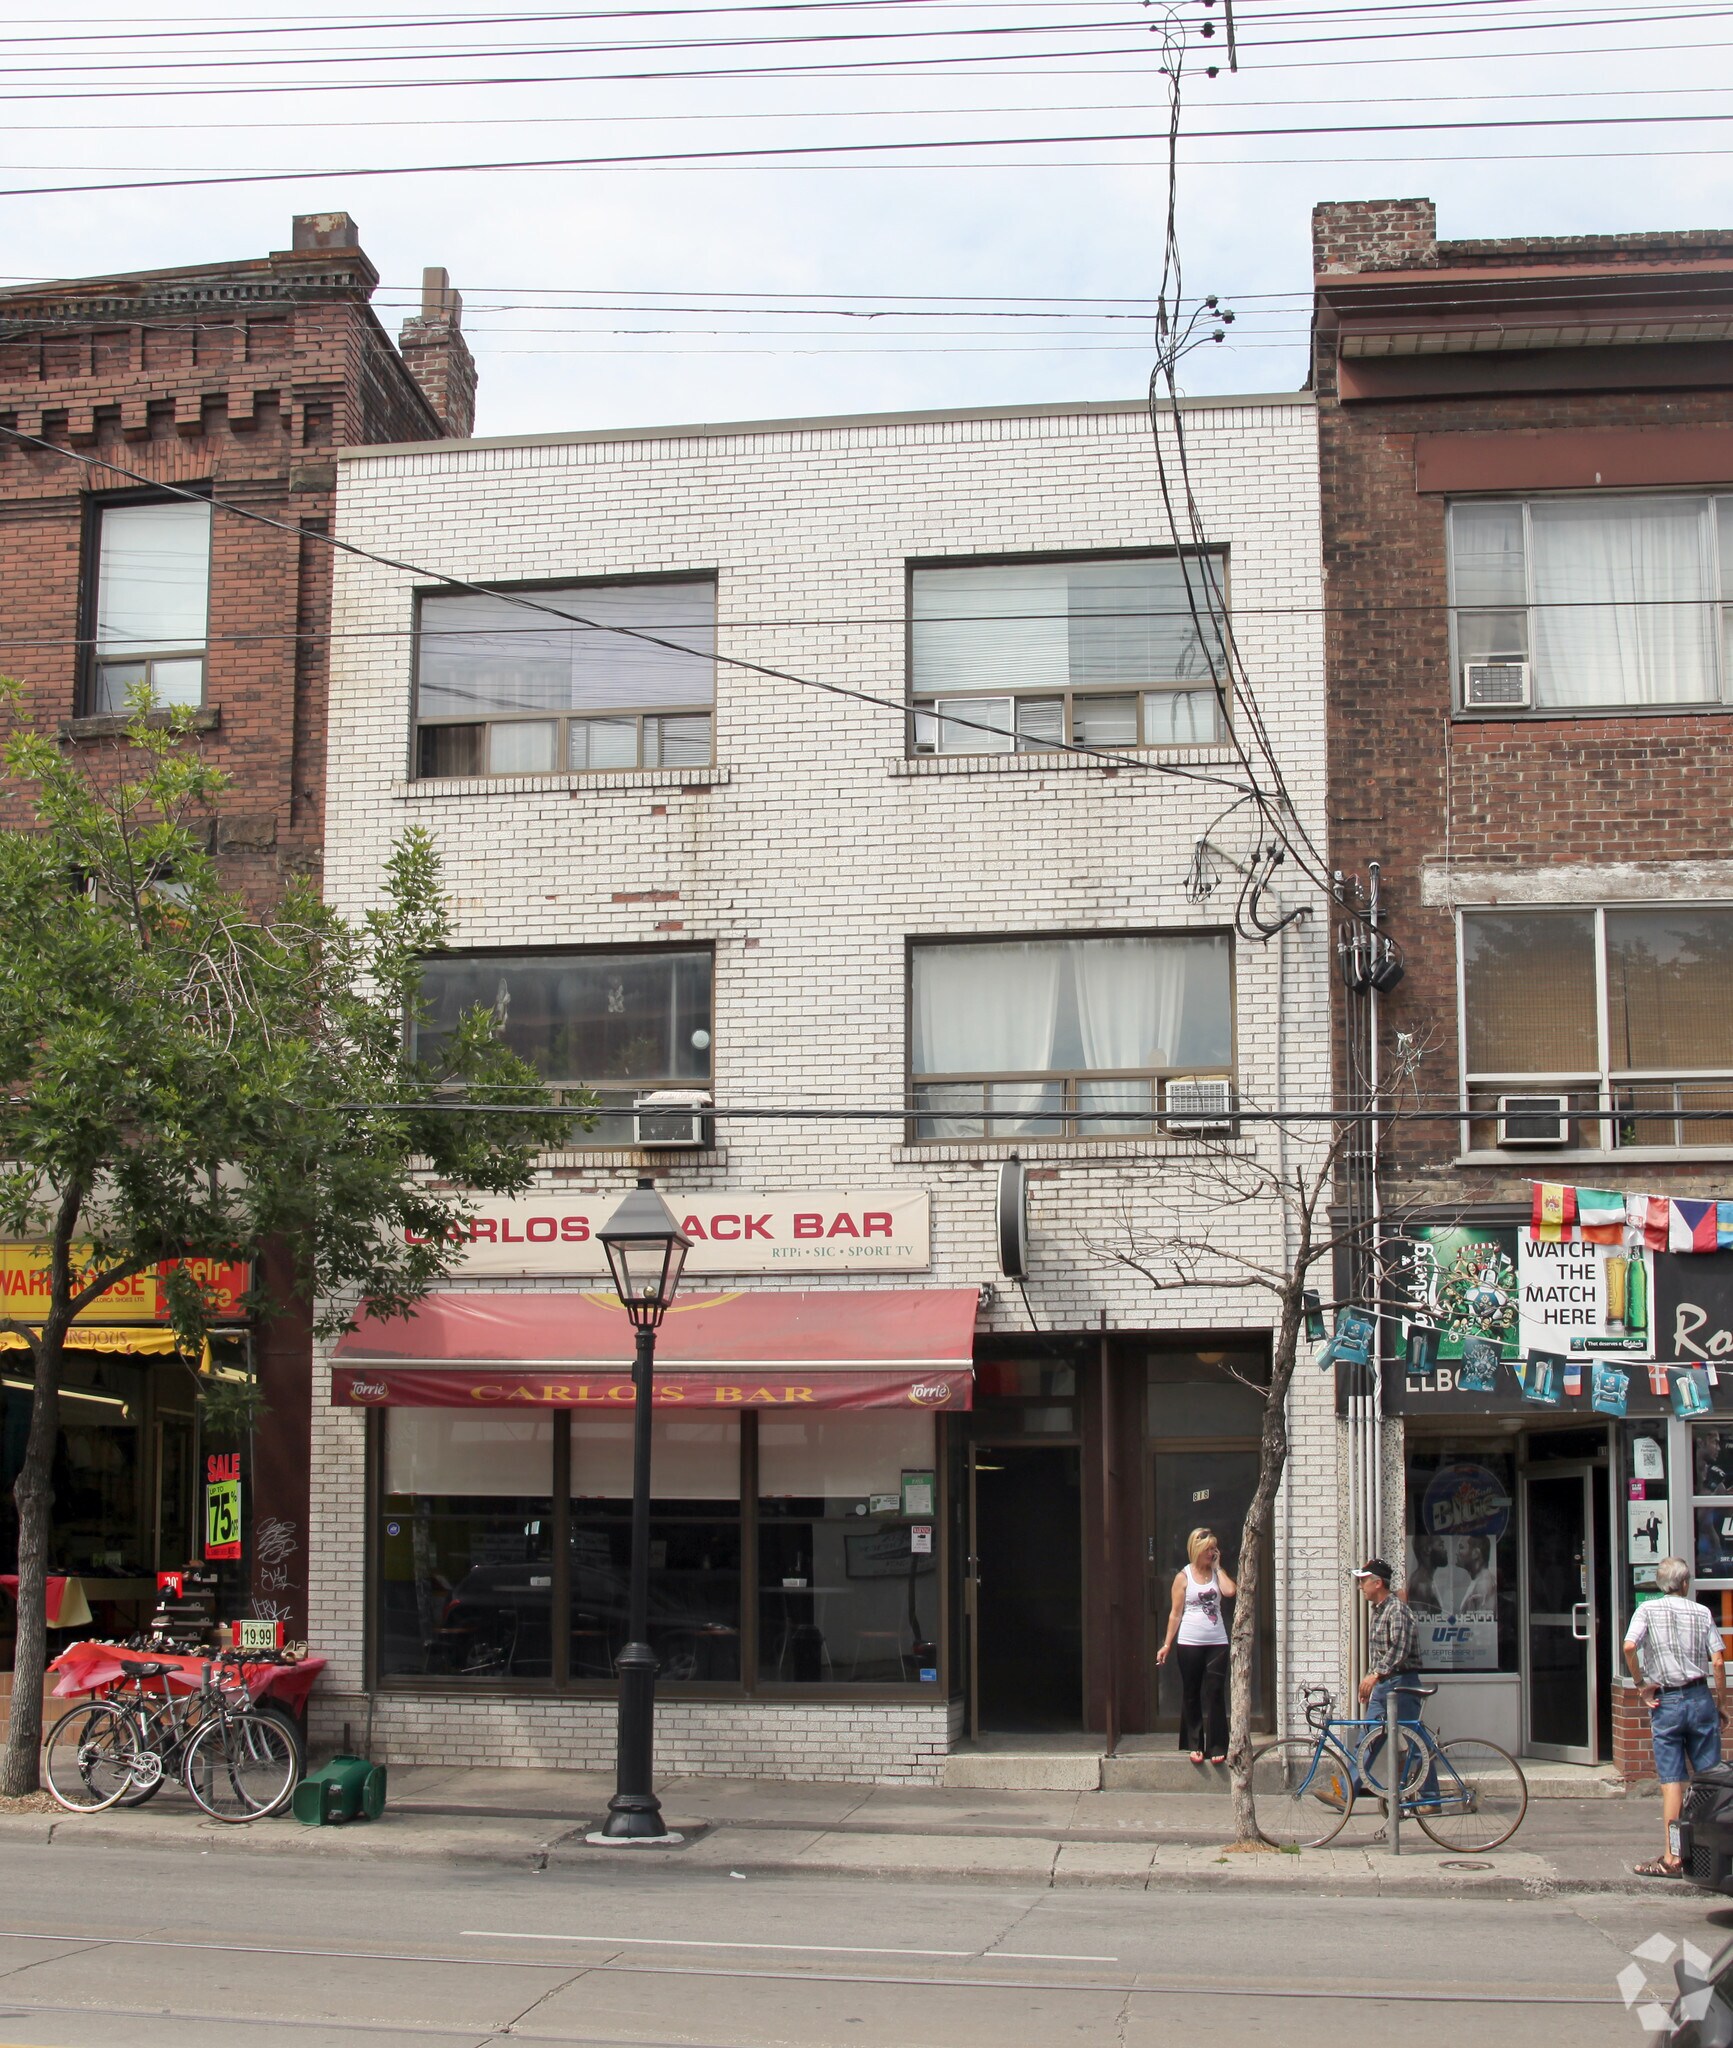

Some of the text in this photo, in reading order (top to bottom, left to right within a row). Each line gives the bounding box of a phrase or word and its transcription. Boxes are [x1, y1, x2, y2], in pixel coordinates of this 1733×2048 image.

[681, 1214, 775, 1240] ACK
[793, 1212, 893, 1238] BAR
[813, 1247, 836, 1257] SIC
[848, 1246, 892, 1257] SPORT
[895, 1246, 914, 1256] TV
[1525, 1241, 1595, 1258] WATCH
[1556, 1264, 1596, 1280] THE
[1525, 1286, 1596, 1302] MATCH
[1544, 1308, 1596, 1325] HERE
[714, 1386, 818, 1402] BAR
[911, 1382, 947, 1398] Torrié
[207, 1453, 240, 1482] SALE
[1193, 1489, 1210, 1501] 818
[244, 1628, 272, 1645] 19.99
[1431, 1627, 1472, 1643] UFC
